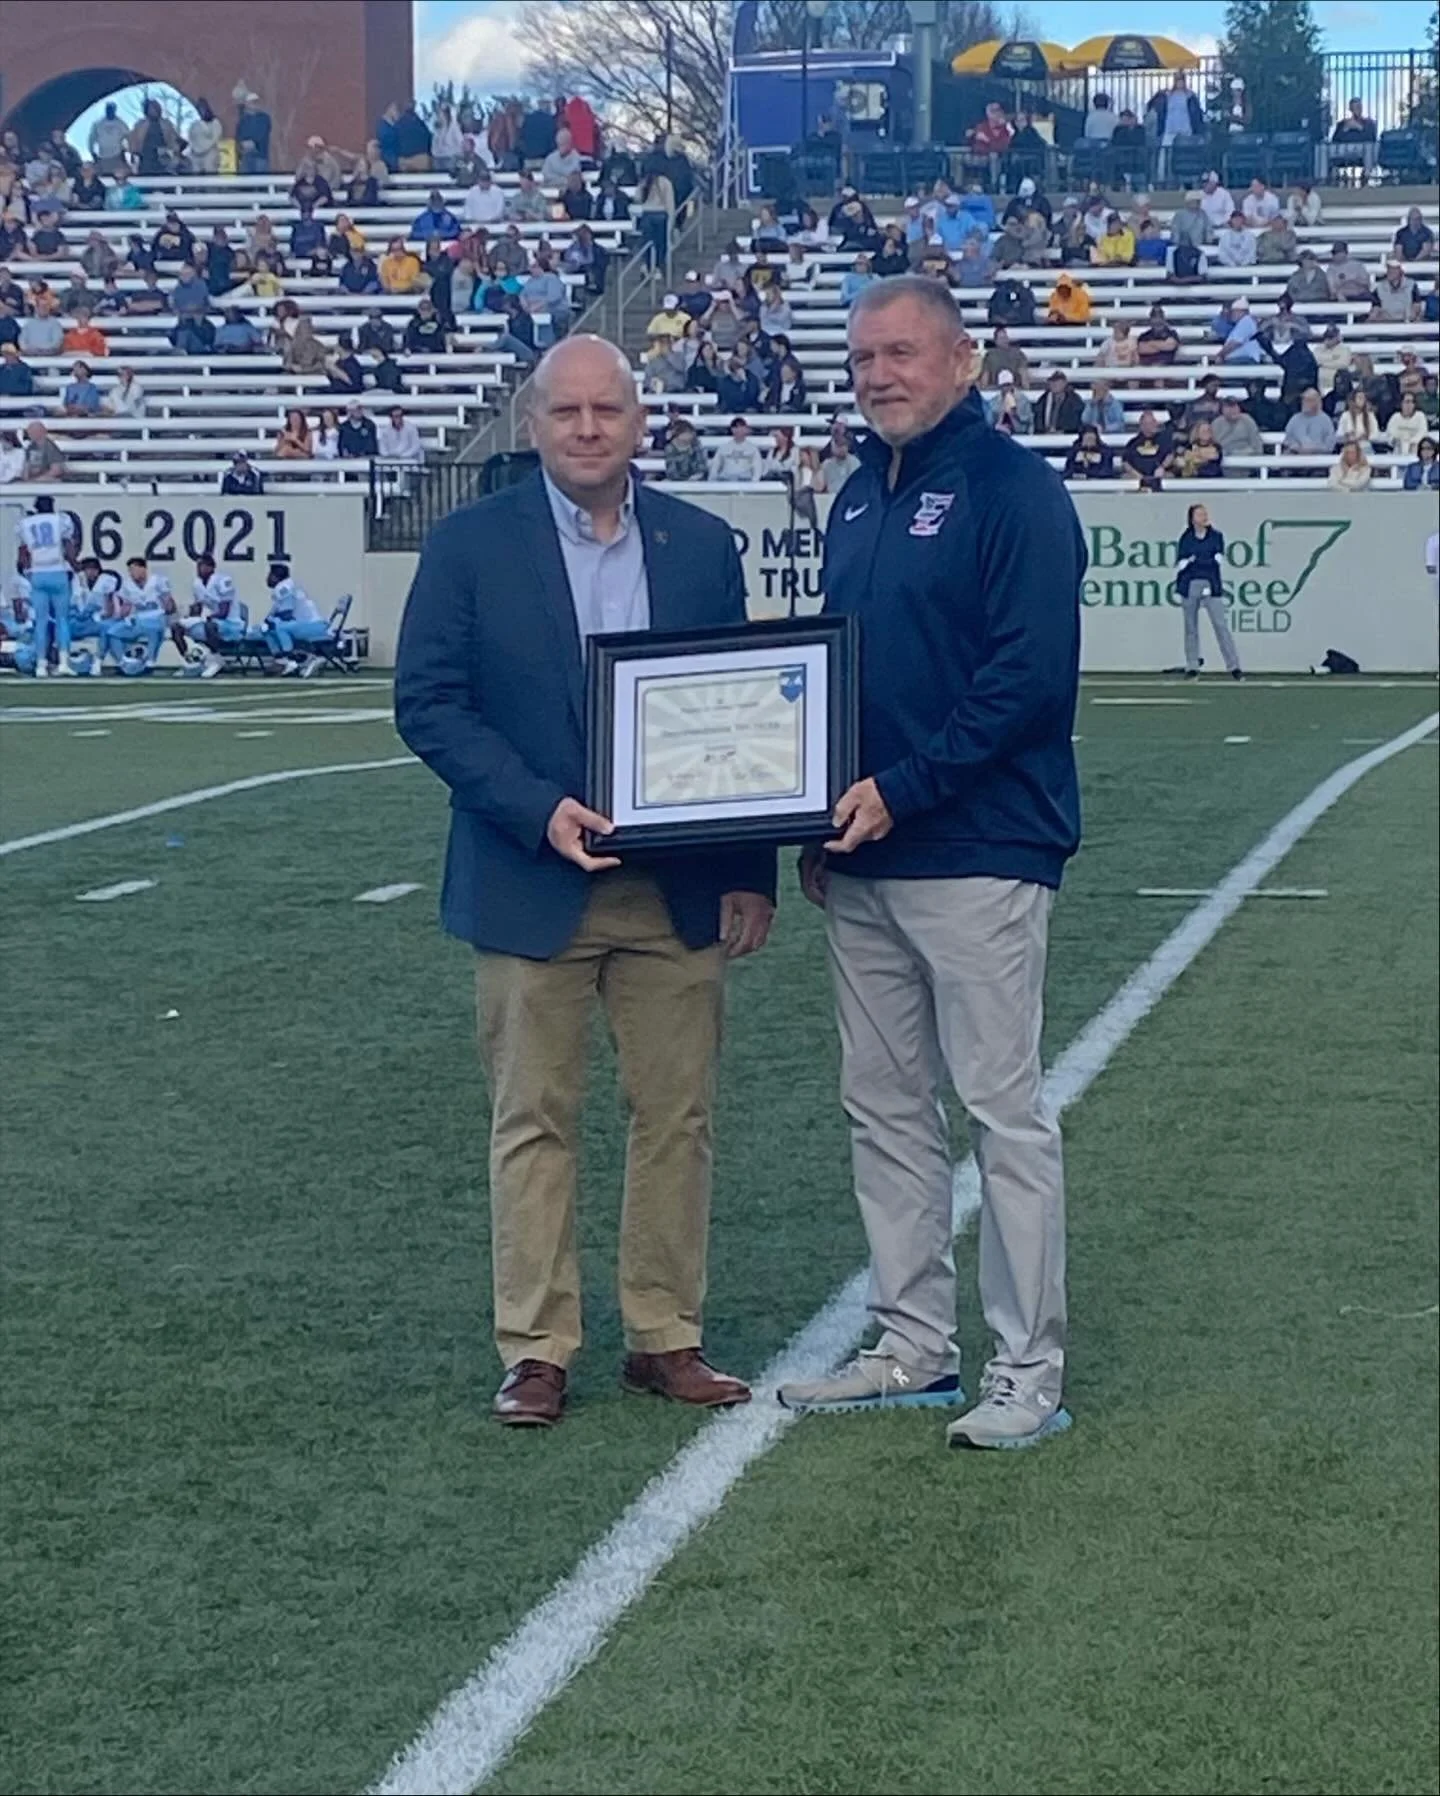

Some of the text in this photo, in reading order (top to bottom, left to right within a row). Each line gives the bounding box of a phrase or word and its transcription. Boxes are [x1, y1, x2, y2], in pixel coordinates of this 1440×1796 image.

[145, 509, 292, 562] 2021
[1088, 525, 1180, 568] Ban
[1080, 578, 1292, 608] ennesee
